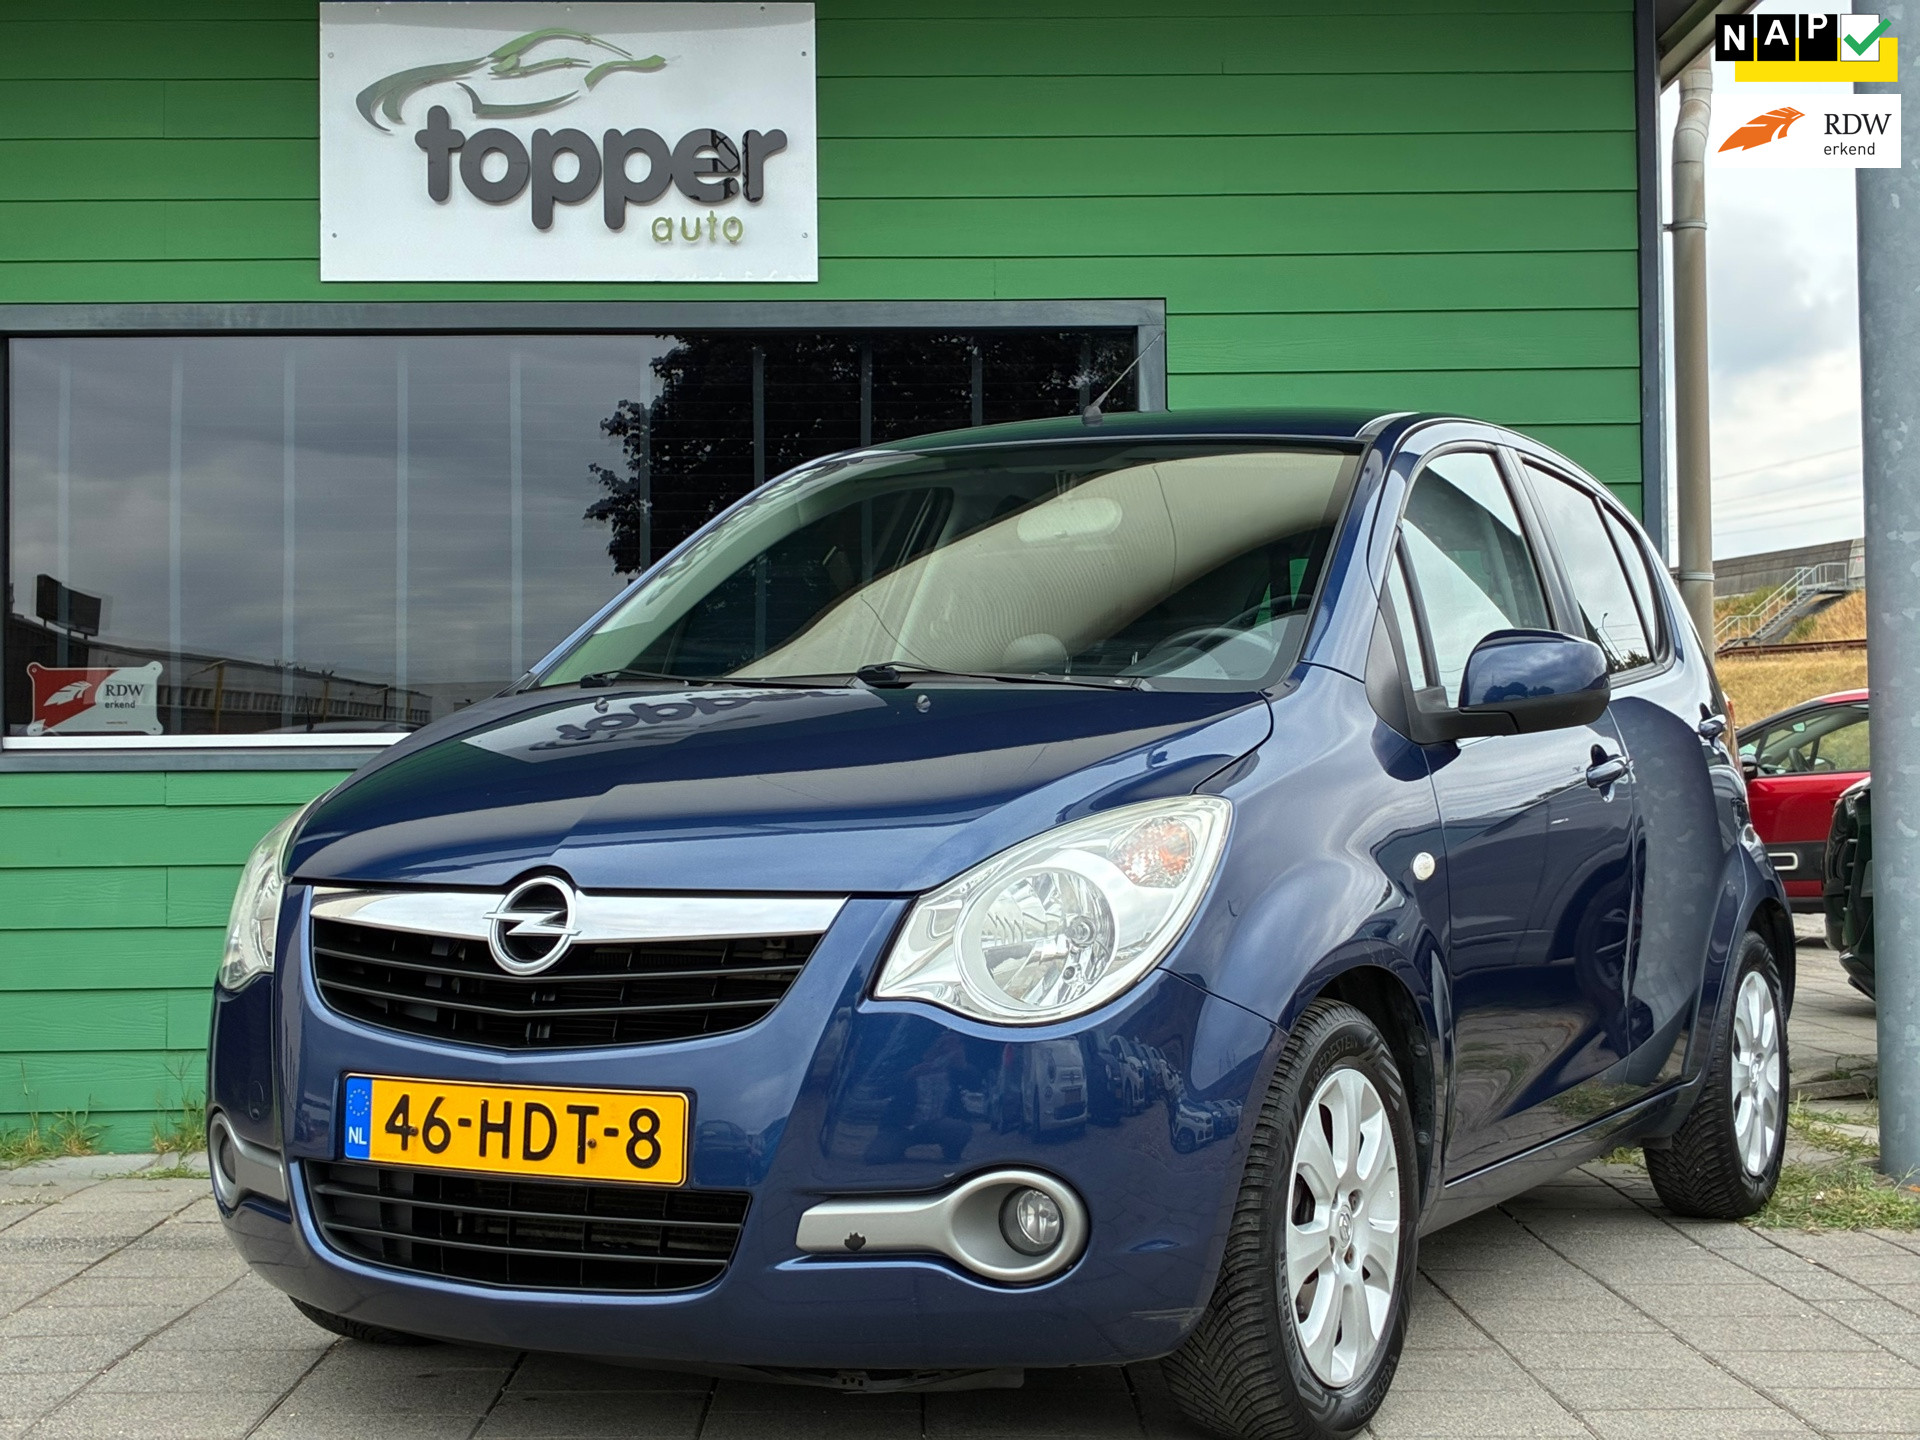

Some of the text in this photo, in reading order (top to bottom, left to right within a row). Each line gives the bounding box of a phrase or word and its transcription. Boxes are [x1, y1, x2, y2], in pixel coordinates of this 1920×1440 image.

[415, 105, 788, 230] topper
[651, 210, 744, 243] auto
[105, 684, 144, 697] RDW
[104, 700, 136, 709] erkend
[347, 1125, 368, 1146] NL
[384, 1093, 662, 1170] 46-HDT-8
